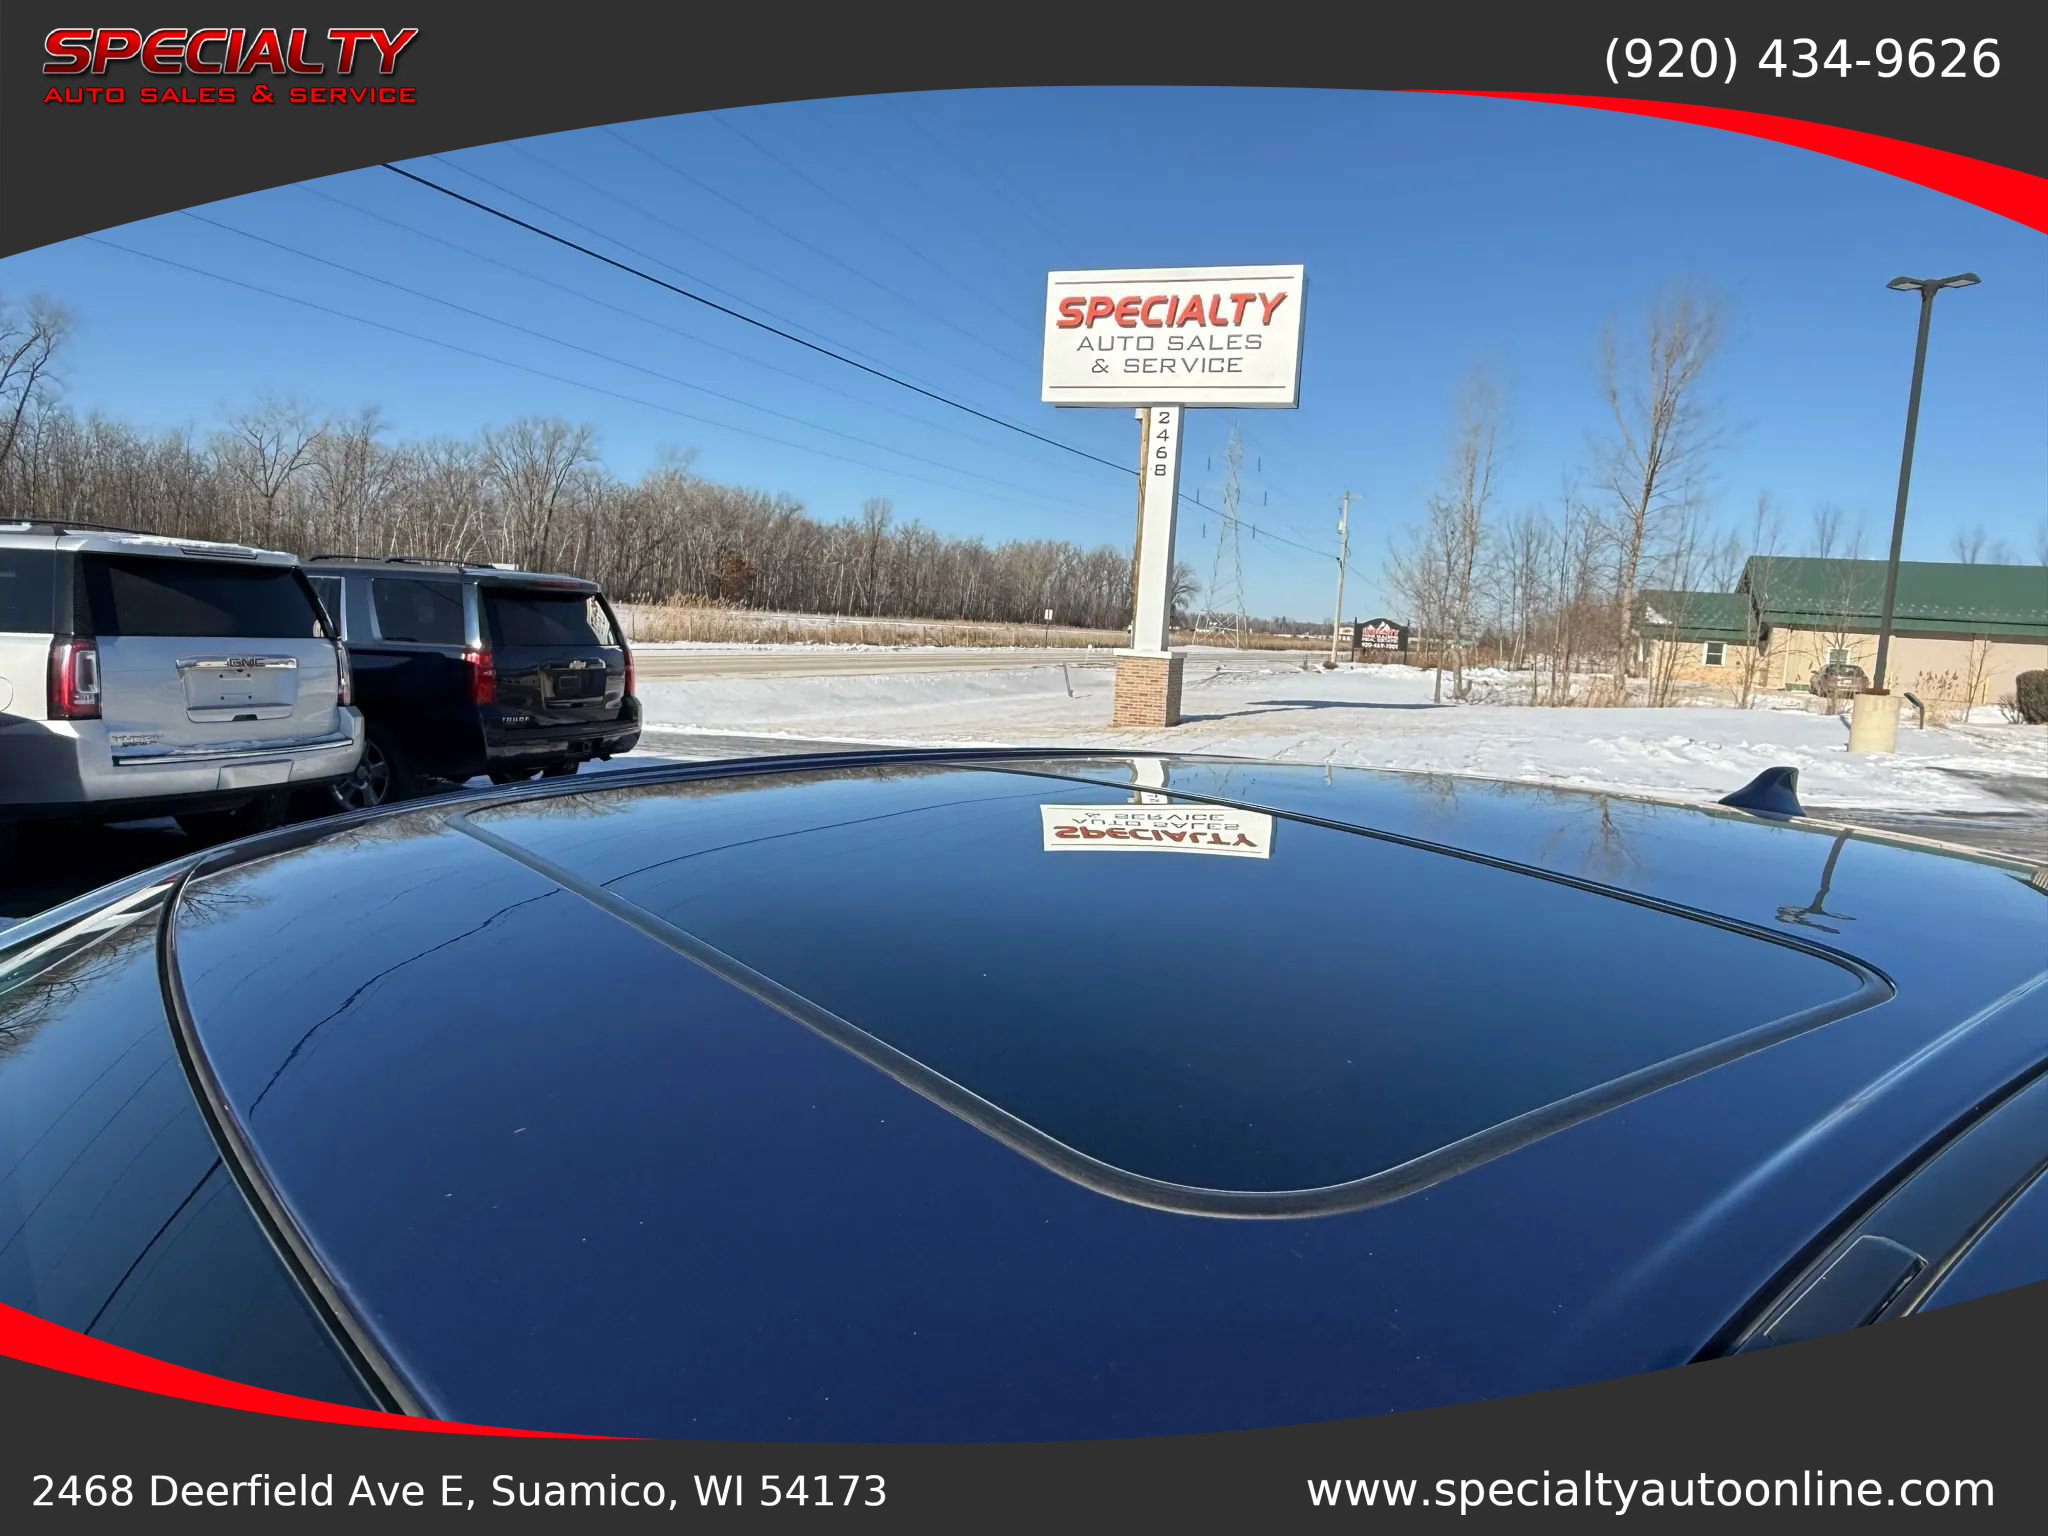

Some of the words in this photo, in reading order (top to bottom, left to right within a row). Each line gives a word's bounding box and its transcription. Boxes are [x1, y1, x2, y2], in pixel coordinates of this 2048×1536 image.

[1056, 292, 1288, 328] SPECIALTY
[1077, 335, 1154, 352] AUTO
[1167, 334, 1262, 350] SALES
[1091, 358, 1109, 374] &
[1123, 357, 1244, 373] SERVICE
[1154, 411, 1171, 477] 2468
[228, 657, 266, 668] GMC
